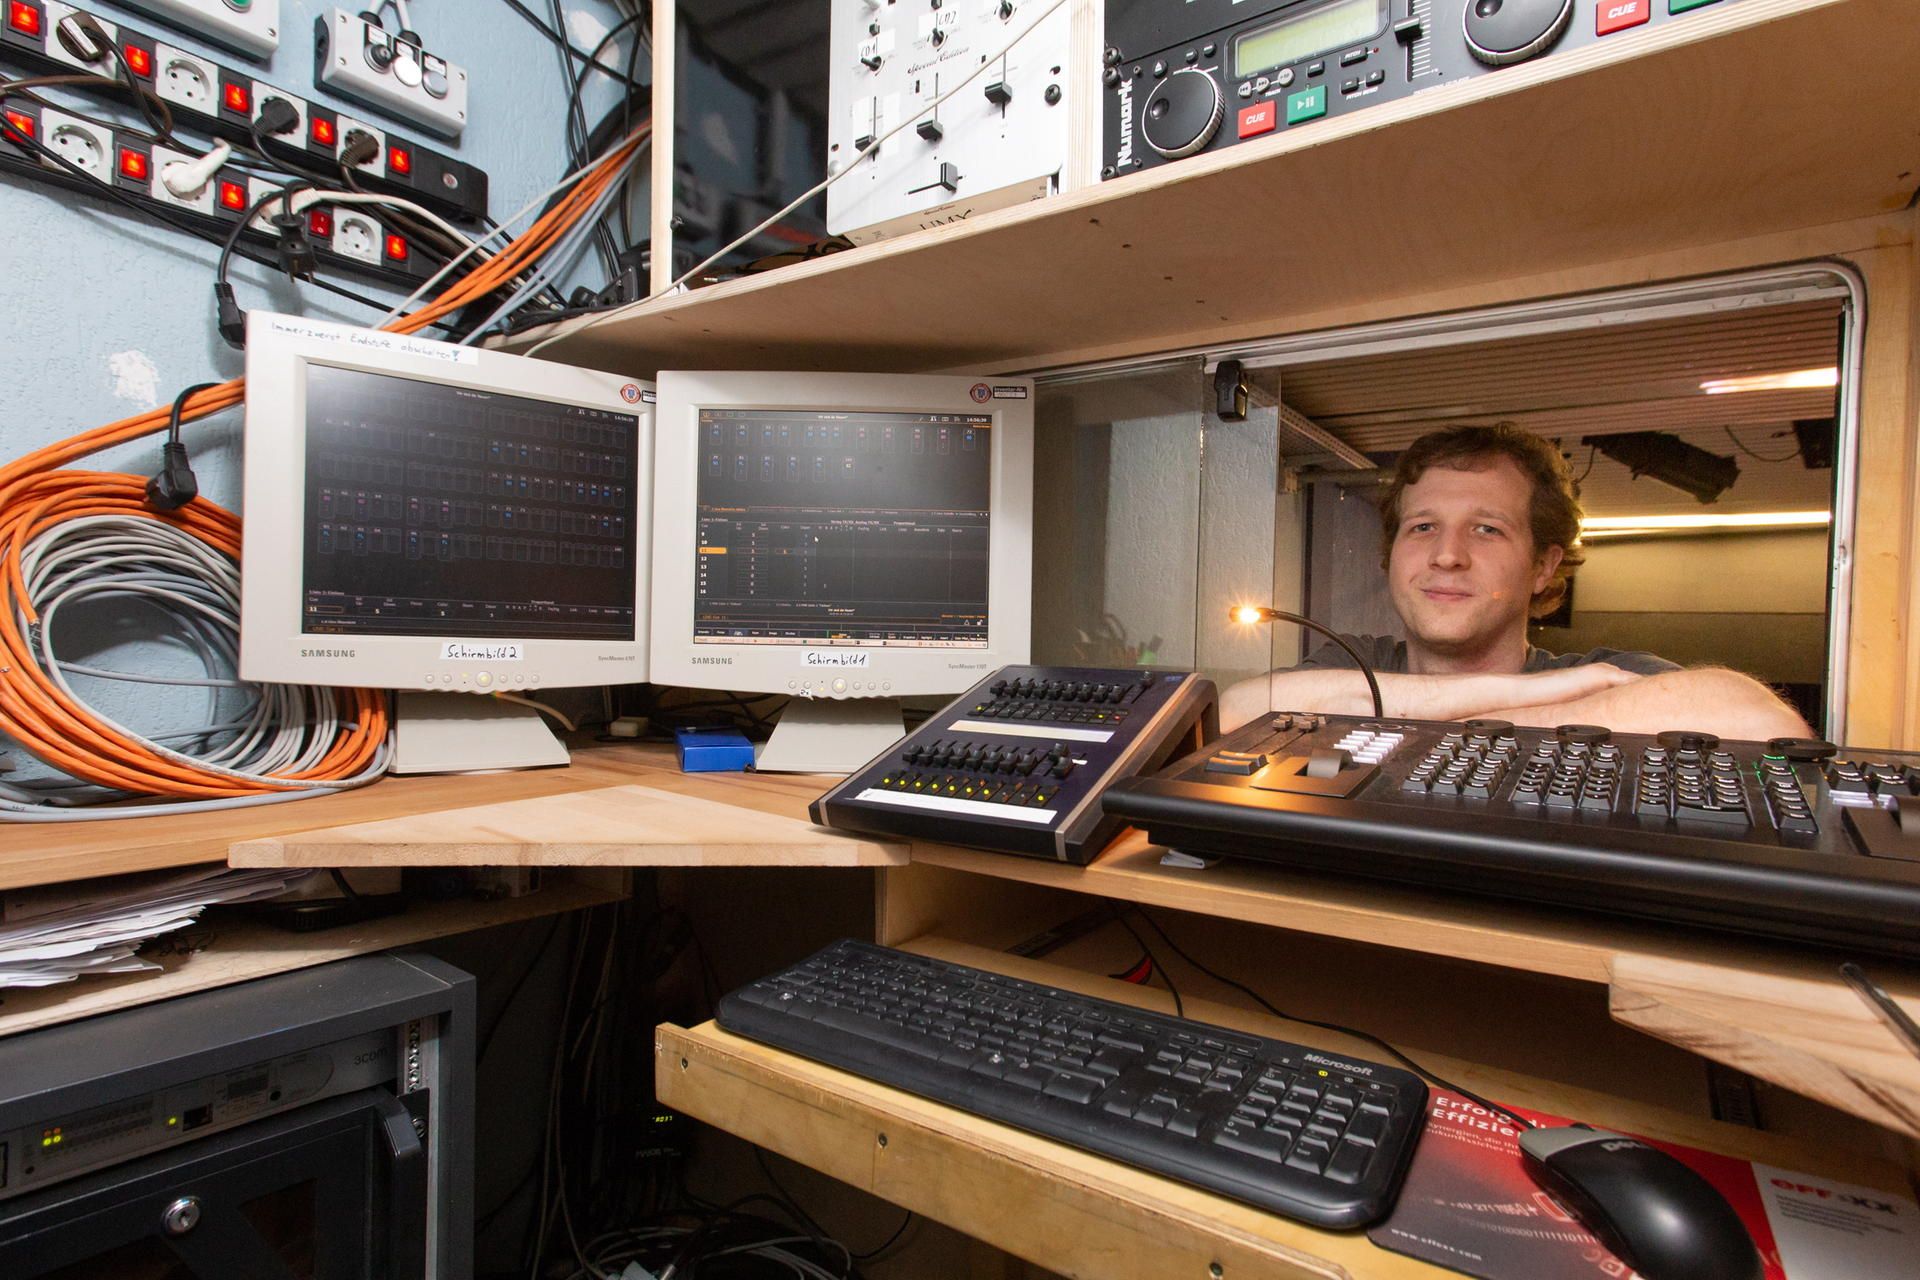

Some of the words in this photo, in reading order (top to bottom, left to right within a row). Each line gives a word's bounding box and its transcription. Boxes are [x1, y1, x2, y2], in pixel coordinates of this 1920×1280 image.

[1608, 2, 1637, 19] CUE
[1117, 78, 1133, 168] Numark
[1245, 111, 1266, 125] CUE
[301, 649, 356, 657] SAMSUNG
[691, 657, 733, 665] SAMSUNG
[1304, 1053, 1373, 1076] Microsoft
